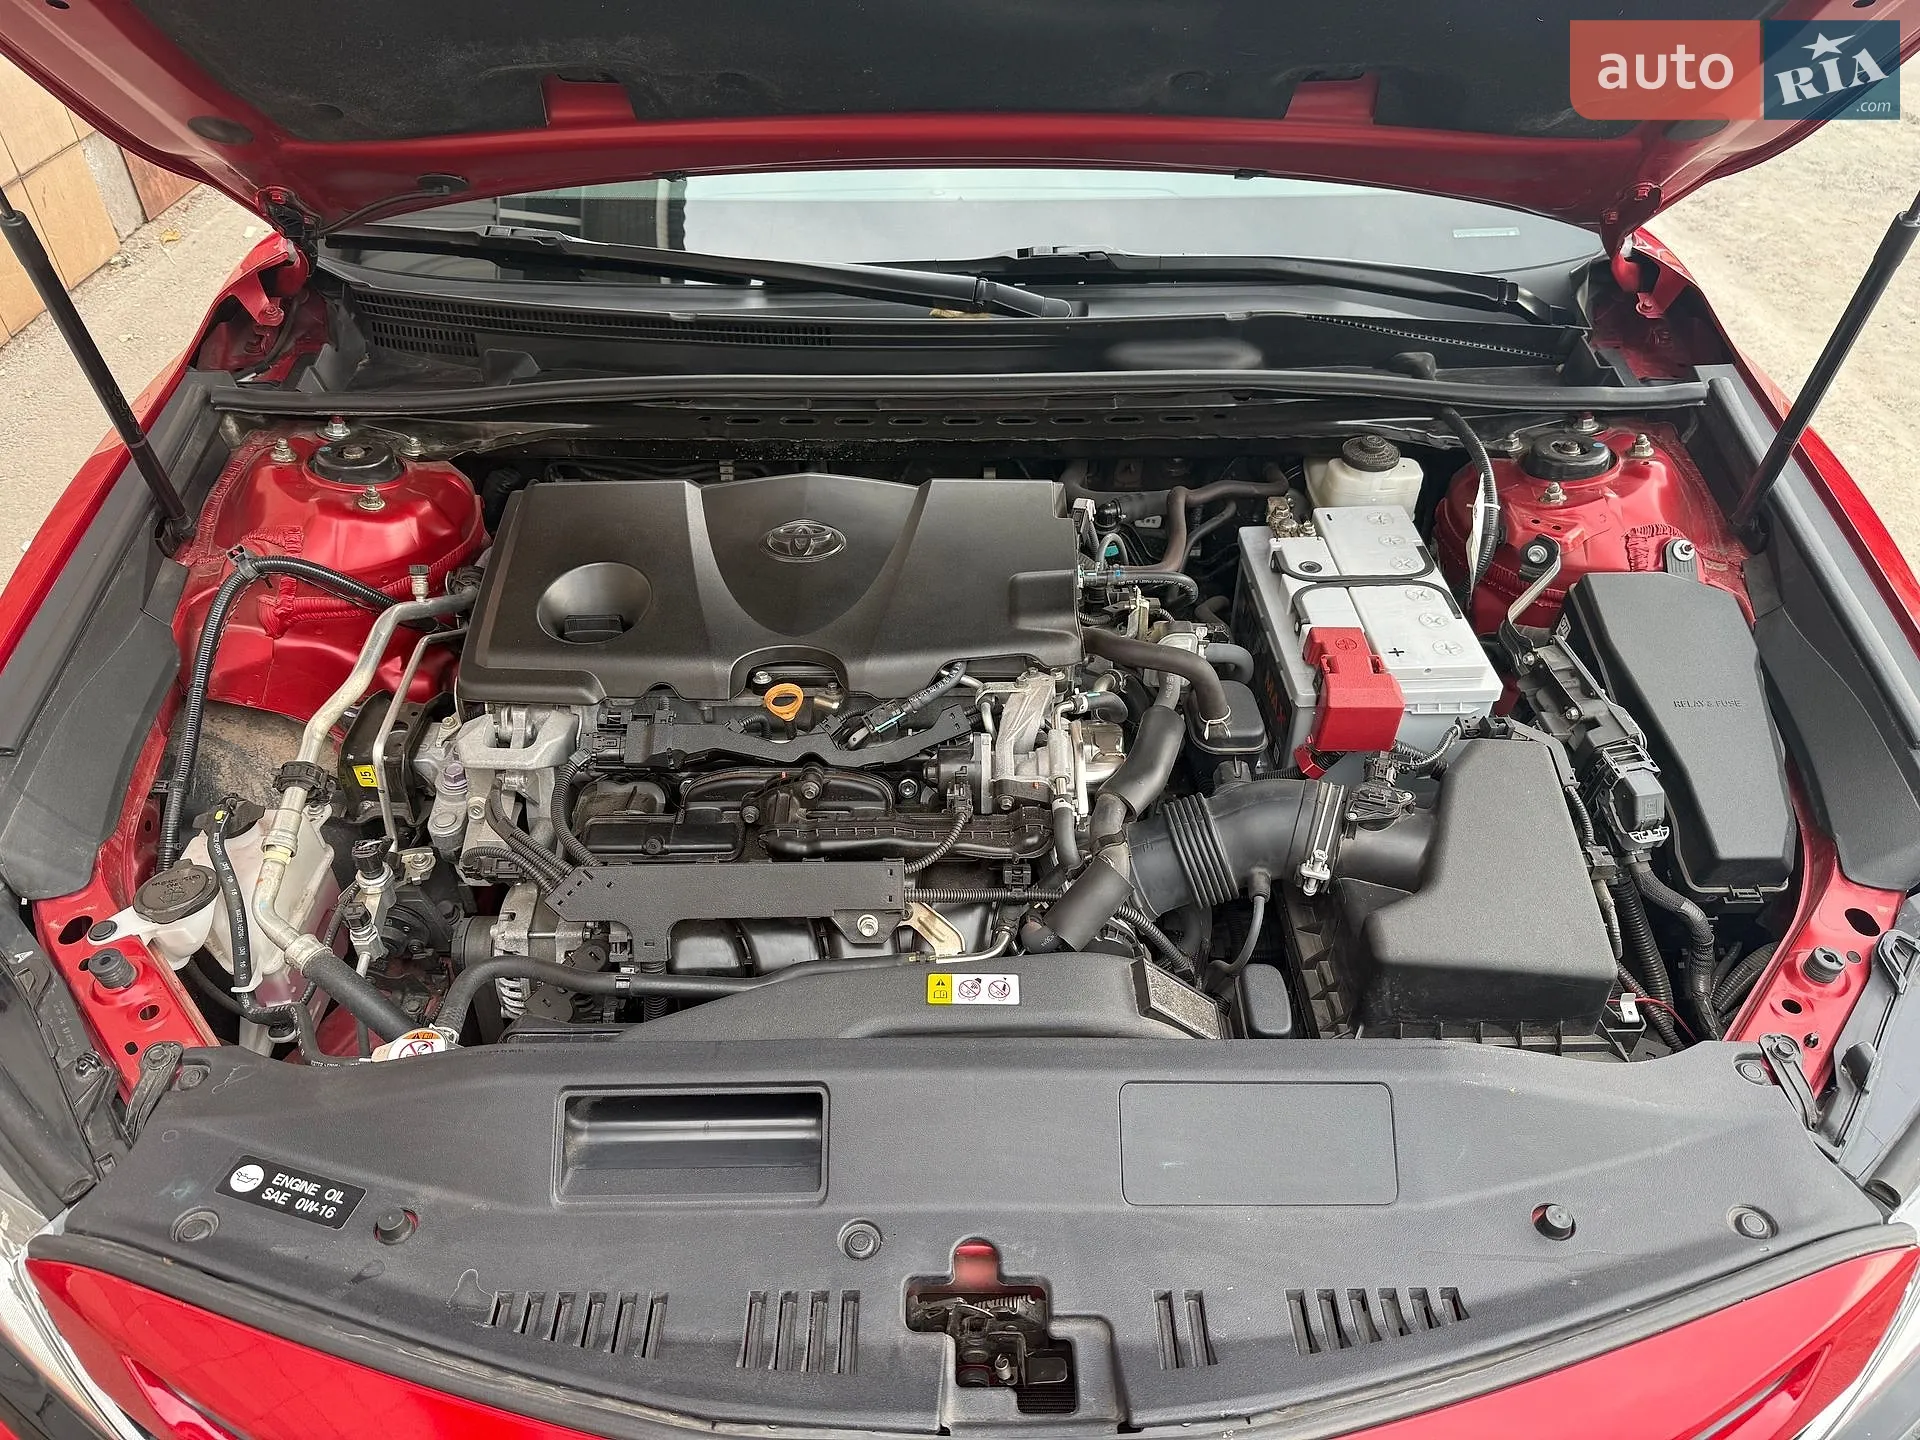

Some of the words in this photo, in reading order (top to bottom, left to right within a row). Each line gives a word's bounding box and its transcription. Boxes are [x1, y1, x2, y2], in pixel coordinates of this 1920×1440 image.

[1673, 699, 1704, 708] RELAY
[1706, 699, 1713, 708] &
[1715, 699, 1742, 708] FUSE
[261, 1187, 292, 1205] SAE
[295, 1197, 337, 1219] 0W-16
[272, 1172, 321, 1196] ENGINE
[324, 1188, 345, 1205] OIL
